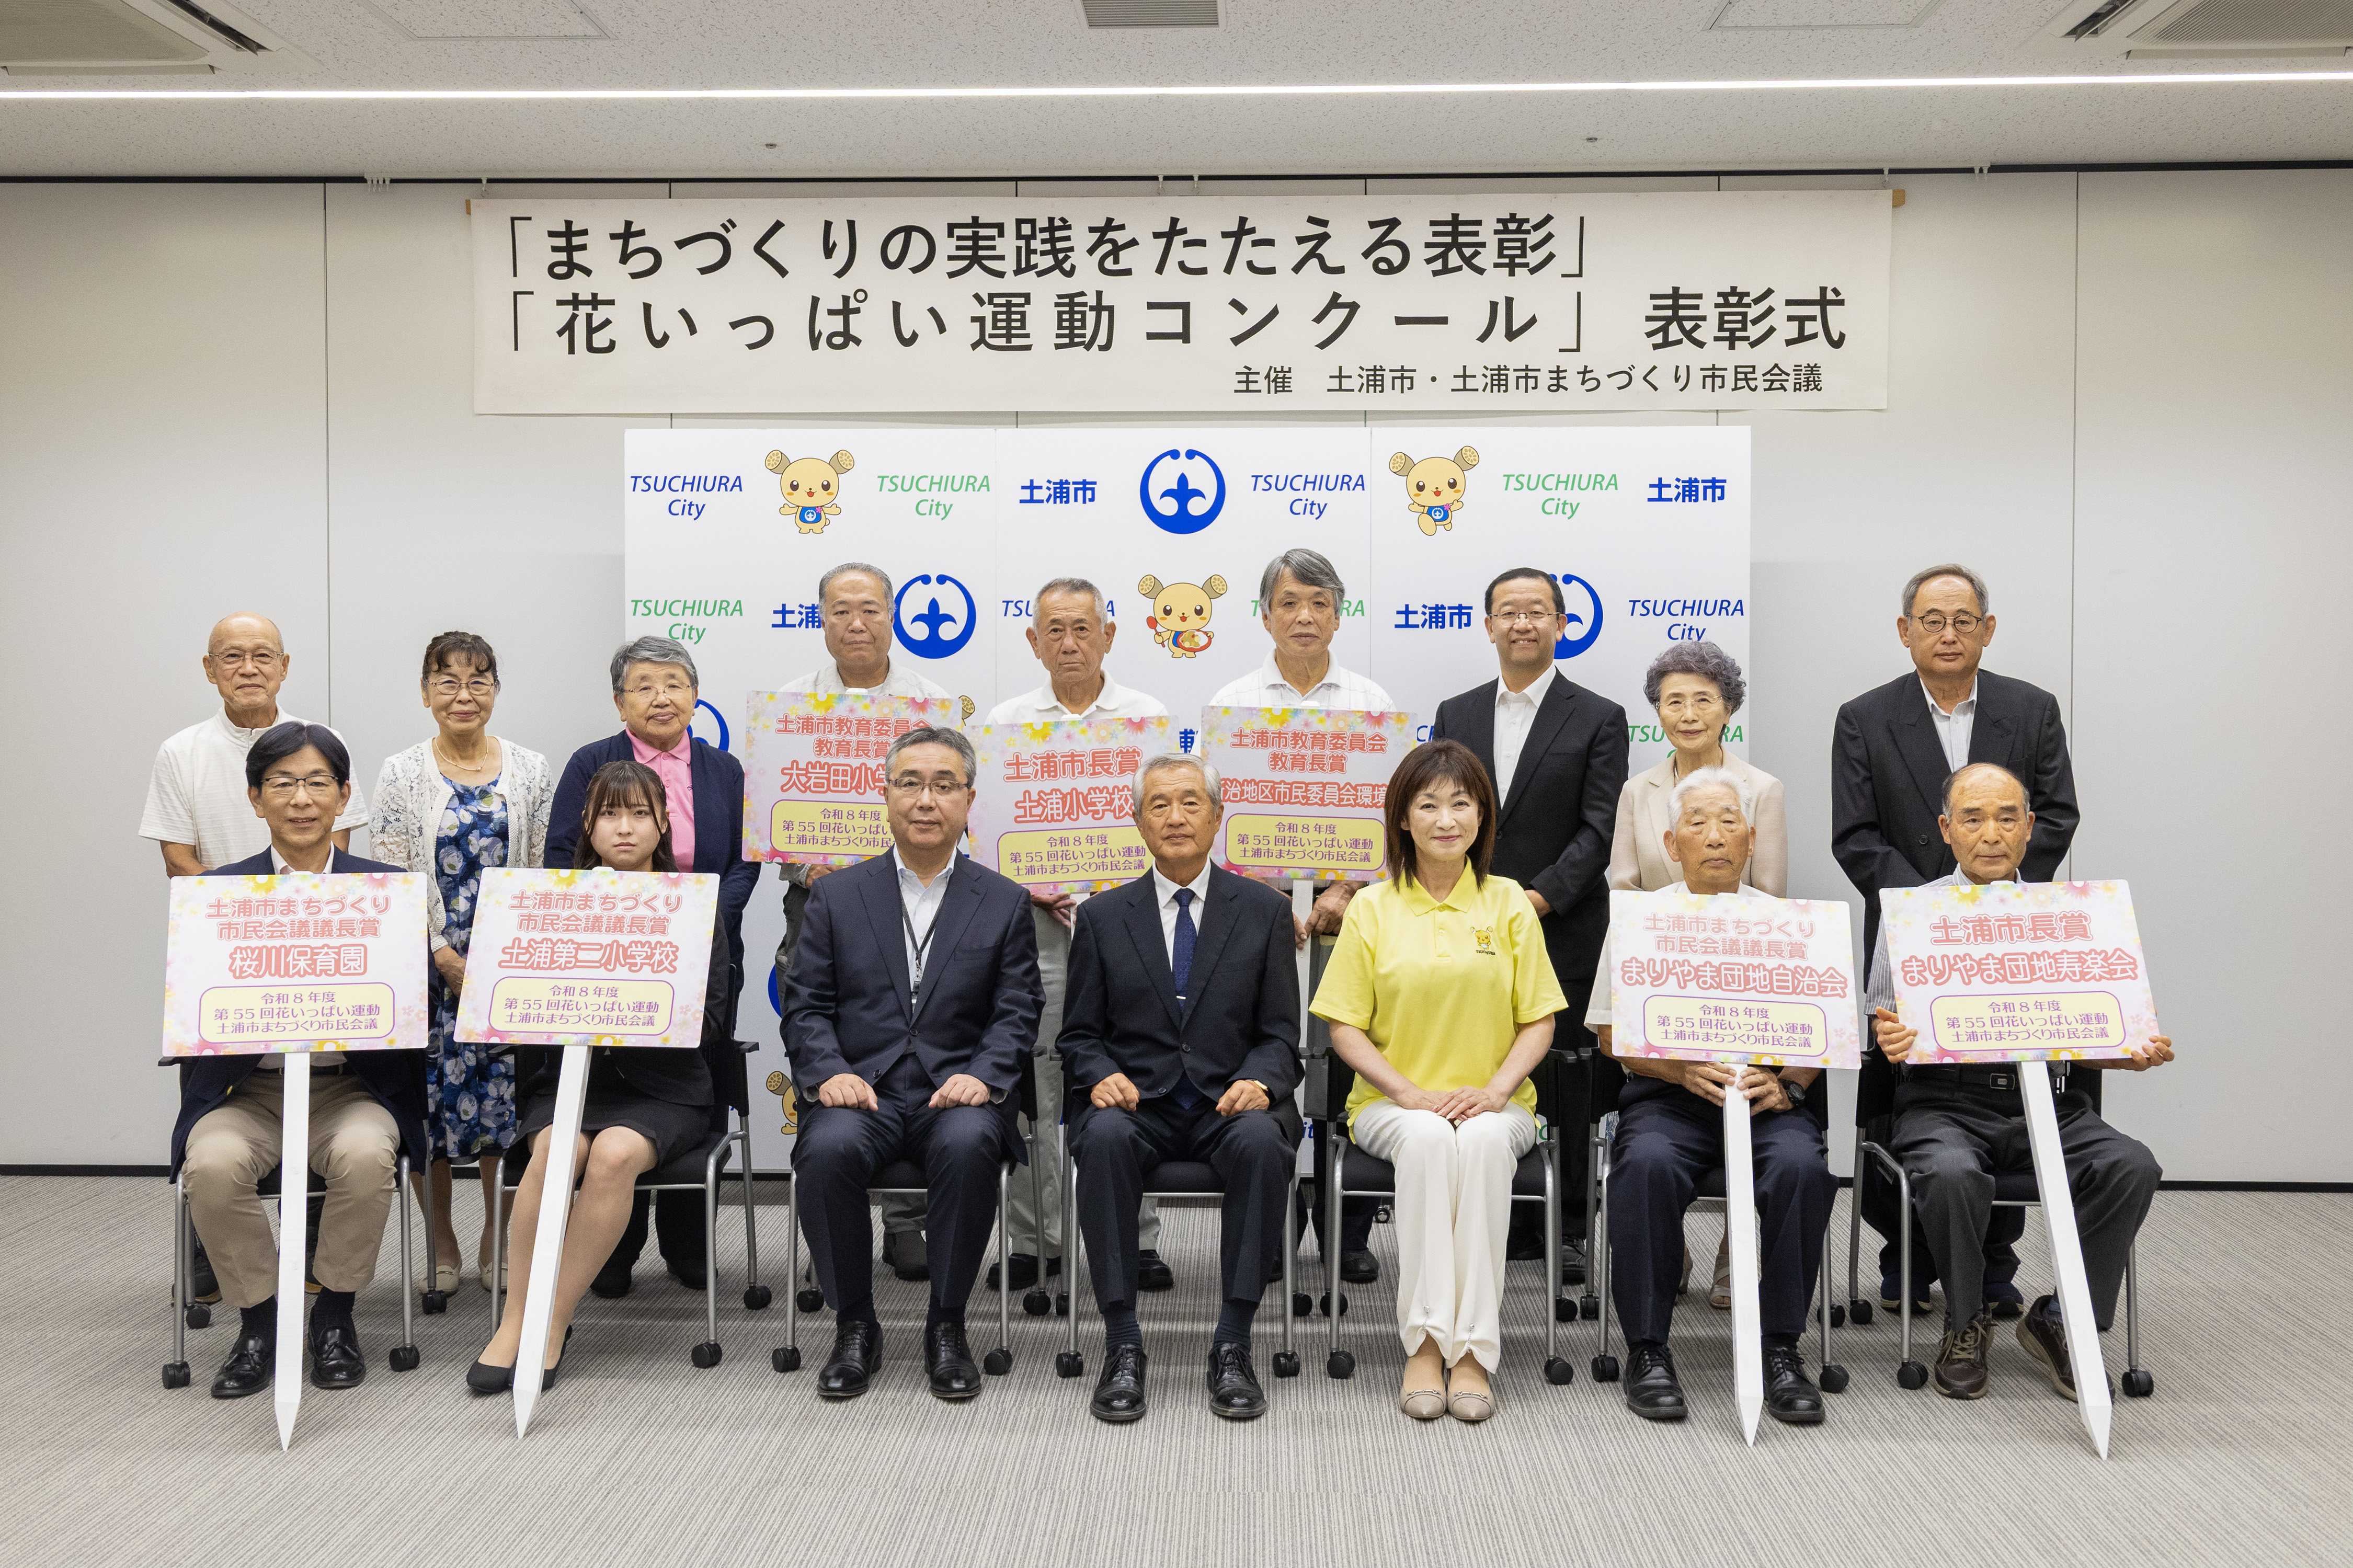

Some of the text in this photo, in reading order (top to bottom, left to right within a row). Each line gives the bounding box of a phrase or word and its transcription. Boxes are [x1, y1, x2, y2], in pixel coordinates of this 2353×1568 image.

[510, 212, 1584, 280] 「まちづくりの実践をたたえる表彰」
[1644, 286, 1846, 351] 表彰式
[1234, 363, 1822, 394] 主催 土浦市・土浦市まちづくり市民会議
[631, 475, 743, 493] TSUCHIURA
[877, 475, 990, 492] TSUCHIURA
[1019, 478, 1097, 505] 土浦市
[1251, 474, 1365, 491] TSUCHIURA
[1503, 474, 1618, 491] TSUCHIURA
[1647, 477, 1727, 503] 土浦市
[668, 499, 705, 521] City
[916, 499, 953, 520] City
[1289, 498, 1328, 520] City
[1541, 498, 1580, 519] City
[631, 599, 743, 616] TSUCHIURA
[771, 603, 821, 629] 土浦
[1394, 603, 1473, 630] 土浦市
[1629, 599, 1744, 617] TSUCHIURA
[668, 623, 706, 645] City
[1667, 623, 1706, 642] City
[1230, 728, 1387, 753] 土浦市教育委員会
[1004, 747, 1143, 782] 土浦市長賞
[1269, 751, 1347, 773] 教育長賞
[1014, 785, 1134, 823] 土浦小学校
[785, 834, 895, 848] 土浦市まちづくり市民
[1240, 848, 1370, 863] 土浦市まちづくり市民会議
[1013, 860, 1145, 876] 土浦市まちづくり市民会議
[205, 895, 391, 919] 土浦市まちづくり
[509, 890, 682, 913] 土浦市まちづくり
[218, 918, 381, 941] 市民会議議長賞
[518, 912, 670, 935] 市民会議議長賞
[1644, 912, 1815, 939] 土浦市まちづくり
[1930, 910, 2093, 945] 土浦市長賞
[499, 937, 679, 974] 土浦第二小学校
[1654, 933, 1808, 960] 市民会議議長賞
[229, 944, 368, 979] 桜川保育園
[1902, 948, 2138, 986] まりやま団地寿楽会
[1621, 957, 1847, 998] まりやま団地自治会
[217, 1019, 378, 1035] 土浦市まちづくり市民会議
[505, 1012, 655, 1027] 土浦市まちづくり市民会議
[1661, 1030, 1811, 1048] 土浦市まちづくり市民会議
[1952, 1027, 2109, 1043] 土浦市まちづくり市民会議
